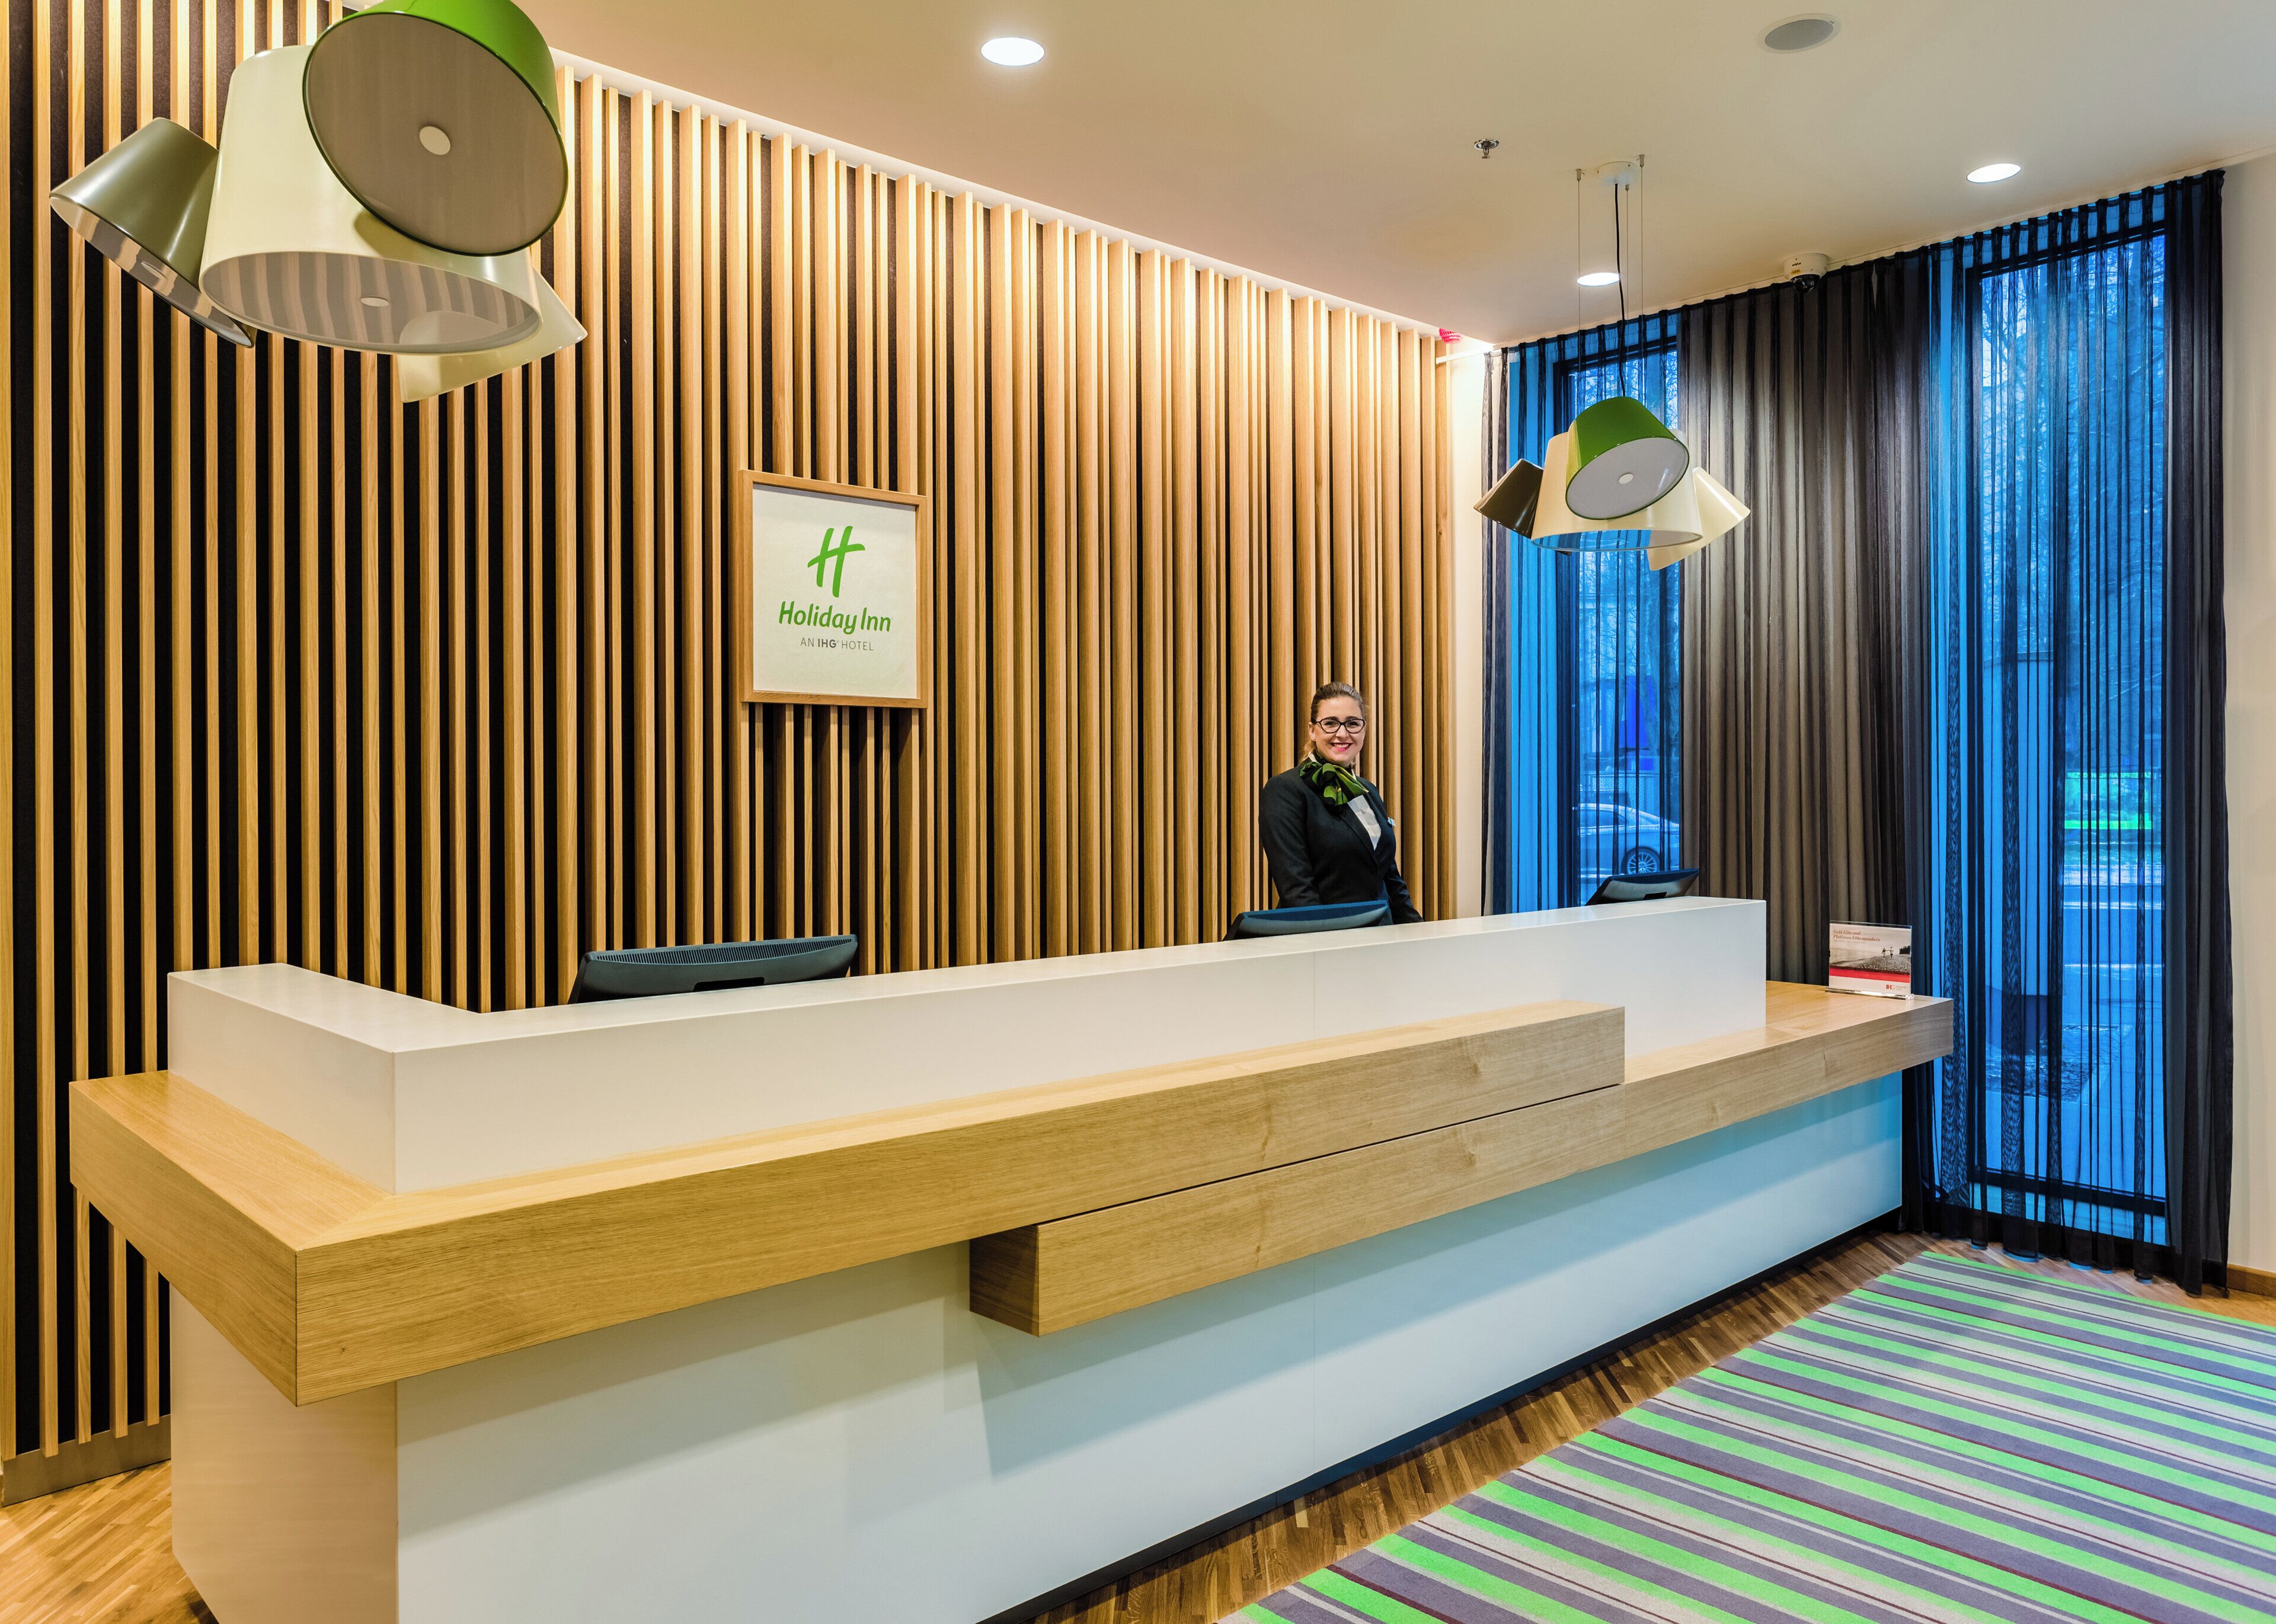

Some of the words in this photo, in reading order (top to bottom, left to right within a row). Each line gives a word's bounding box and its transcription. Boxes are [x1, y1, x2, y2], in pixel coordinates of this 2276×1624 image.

[778, 600, 858, 635] Holiday
[861, 607, 891, 632] Inn
[800, 637, 814, 647] AN
[842, 640, 874, 651] HOTEL
